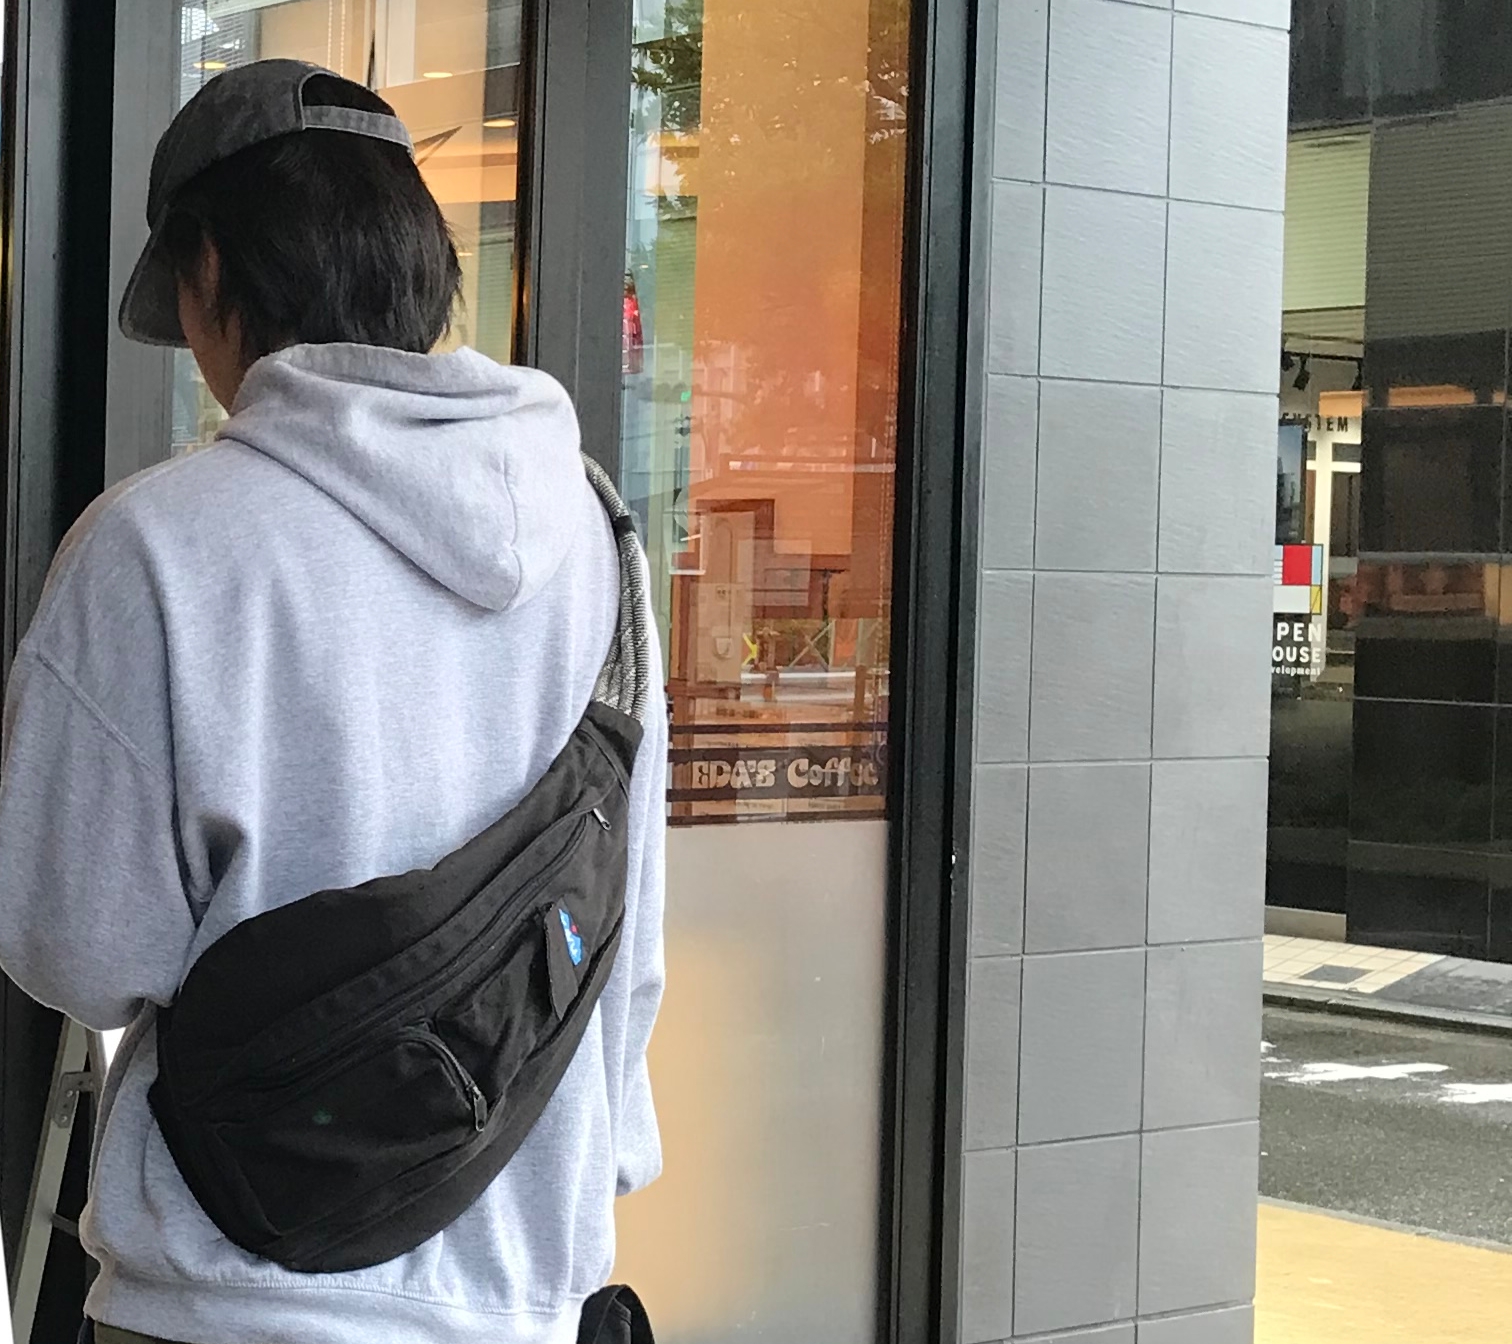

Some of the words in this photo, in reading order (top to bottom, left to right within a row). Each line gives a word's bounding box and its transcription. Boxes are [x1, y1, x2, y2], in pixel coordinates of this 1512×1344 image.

[1277, 622, 1321, 641] PEN
[1272, 646, 1321, 662] OUSE
[1272, 665, 1321, 676] velopment
[787, 757, 879, 788] Coffee
